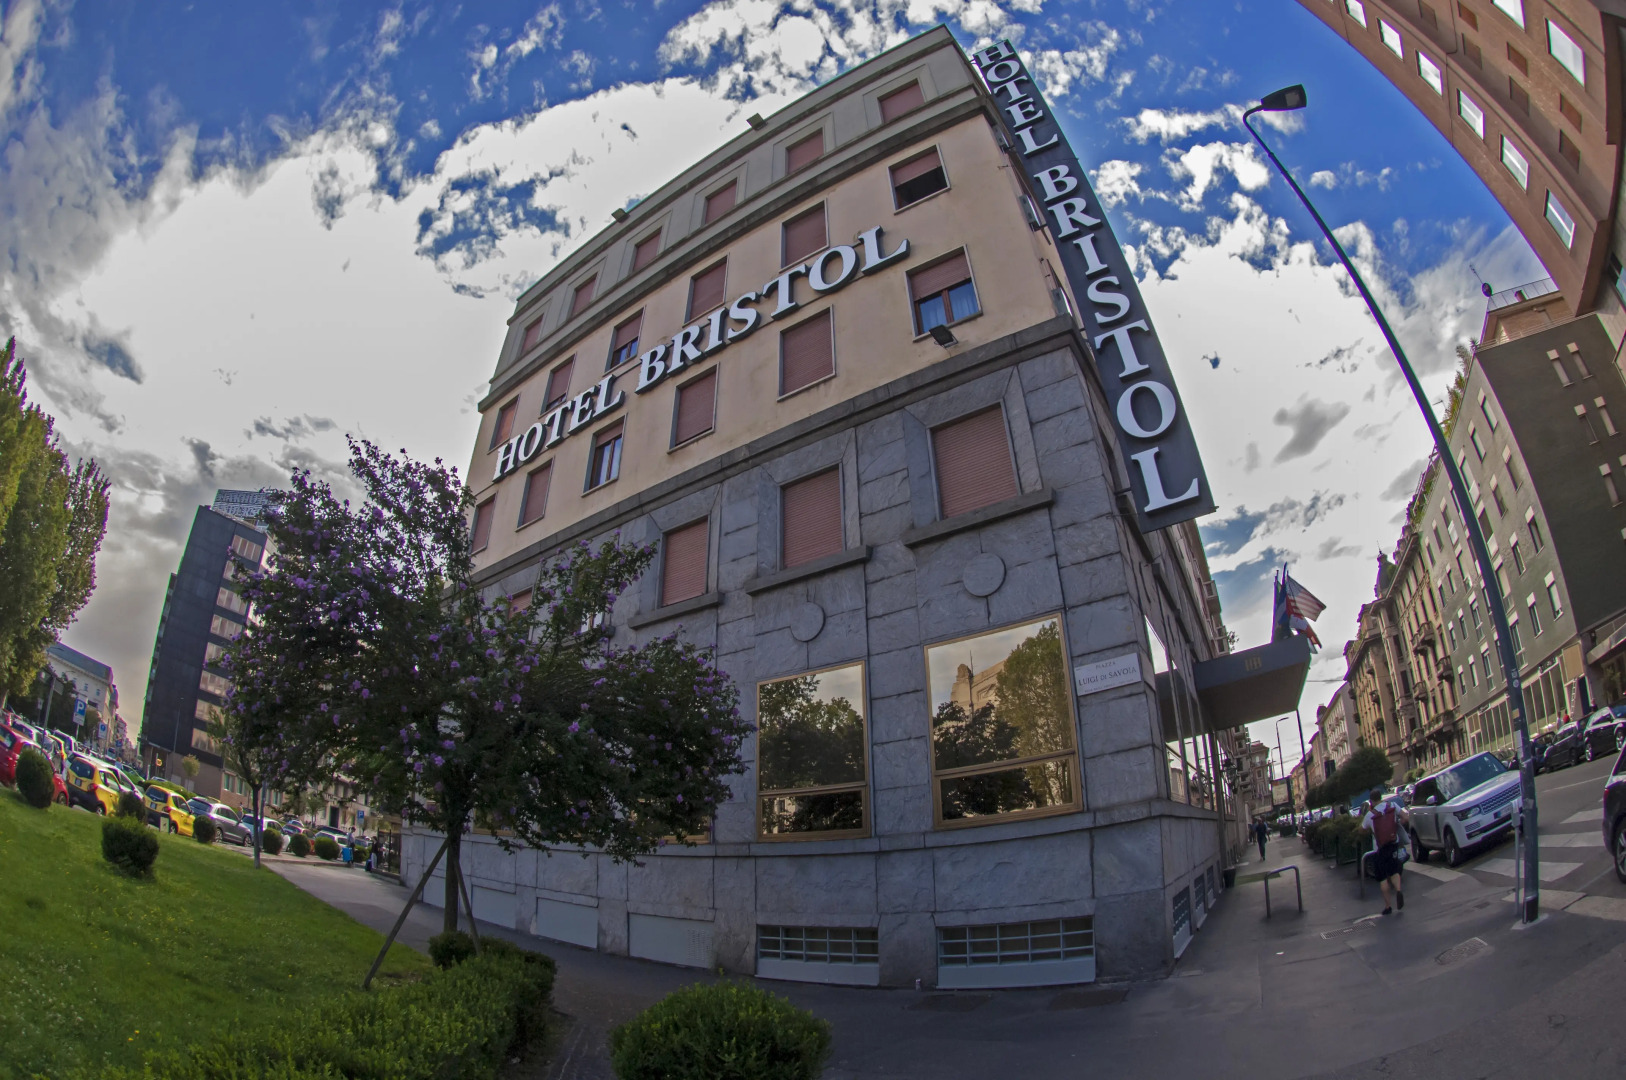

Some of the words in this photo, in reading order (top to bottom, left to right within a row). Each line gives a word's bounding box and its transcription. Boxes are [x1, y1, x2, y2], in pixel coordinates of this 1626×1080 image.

[974, 40, 1059, 156] HOTEL
[1033, 164, 1199, 513] BRISTOL
[492, 374, 625, 482] HOTEL
[635, 225, 910, 395] BRISTOL
[1095, 661, 1116, 670] PIAZZA
[1078, 675, 1099, 686] LUIGI
[1108, 666, 1137, 679] SAVOIA
[76, 701, 85, 713] P
